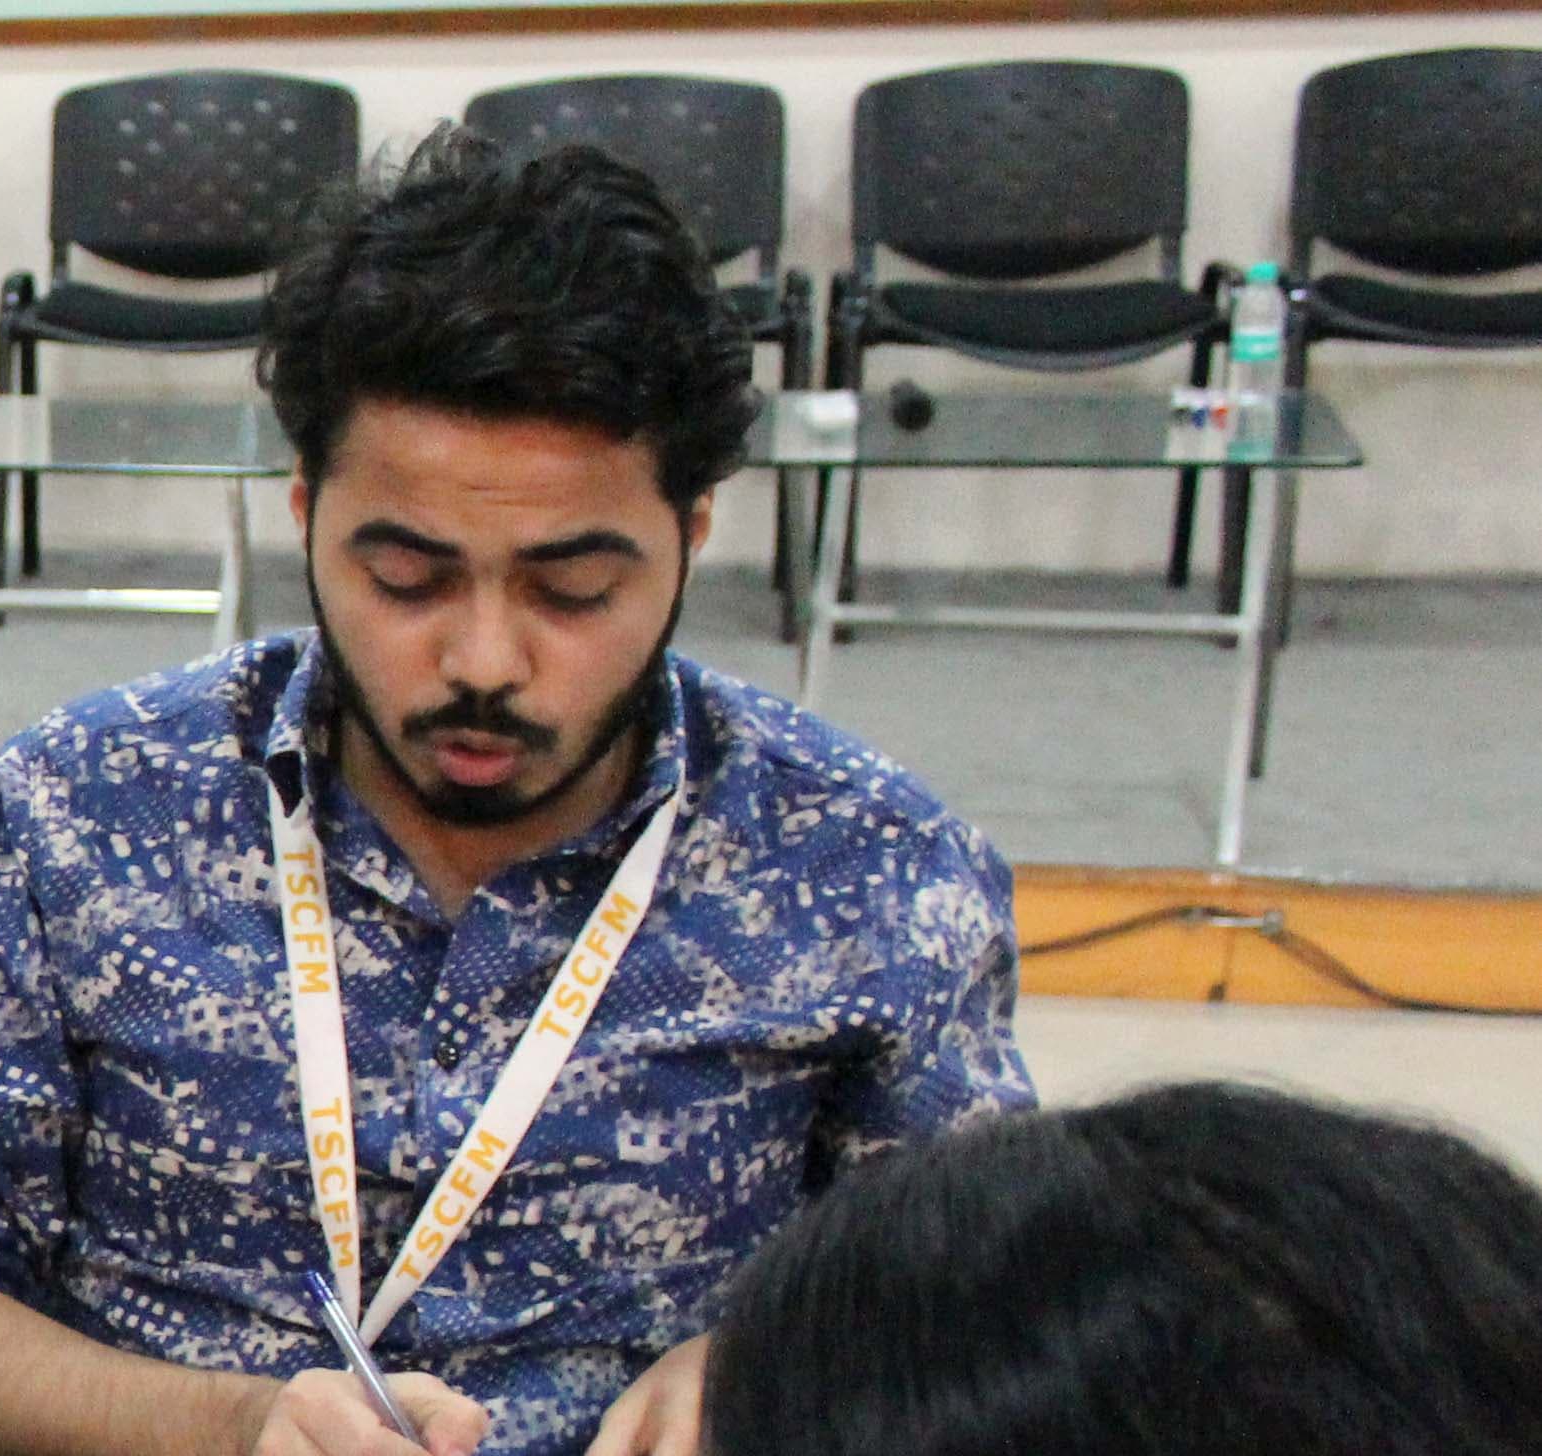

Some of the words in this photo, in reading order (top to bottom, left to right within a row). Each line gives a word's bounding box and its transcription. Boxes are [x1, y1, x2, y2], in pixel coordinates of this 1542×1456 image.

[281, 848, 330, 995] TSCFM
[536, 891, 639, 1042] TSCFM
[310, 1097, 355, 1268] TSCFM
[395, 1130, 507, 1281] TSCFM
